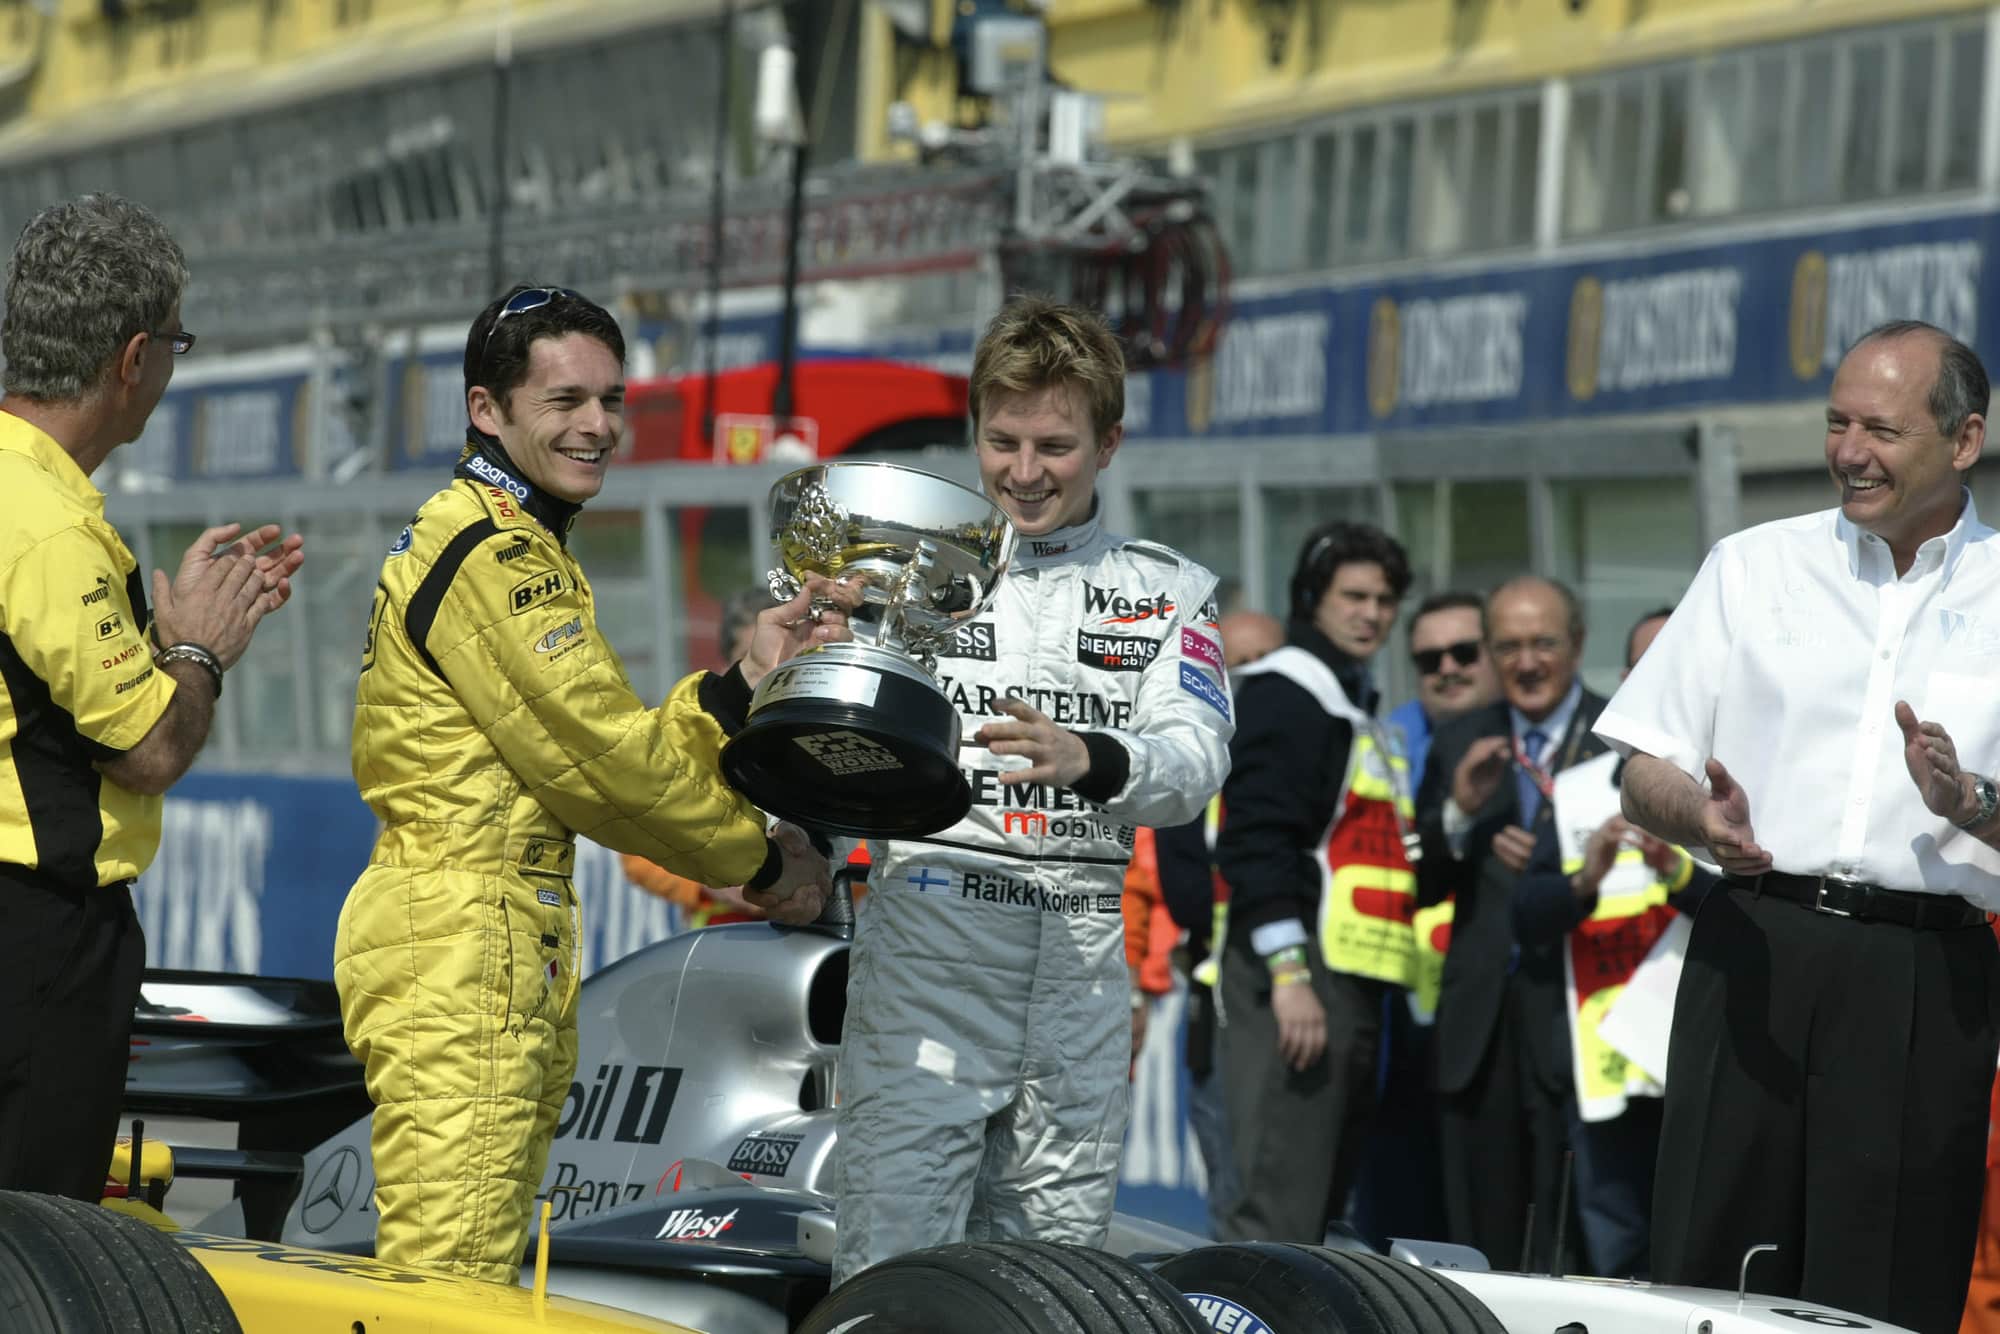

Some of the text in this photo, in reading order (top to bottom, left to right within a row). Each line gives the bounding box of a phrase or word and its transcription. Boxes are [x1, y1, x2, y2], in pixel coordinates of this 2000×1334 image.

[515, 574, 561, 609] B+H
[1082, 579, 1174, 620] West
[955, 626, 992, 648] SS
[1079, 635, 1158, 657] SIEMENS
[1004, 811, 1112, 841] mobile
[734, 1141, 793, 1165] BOSS
[656, 1208, 739, 1239] West
